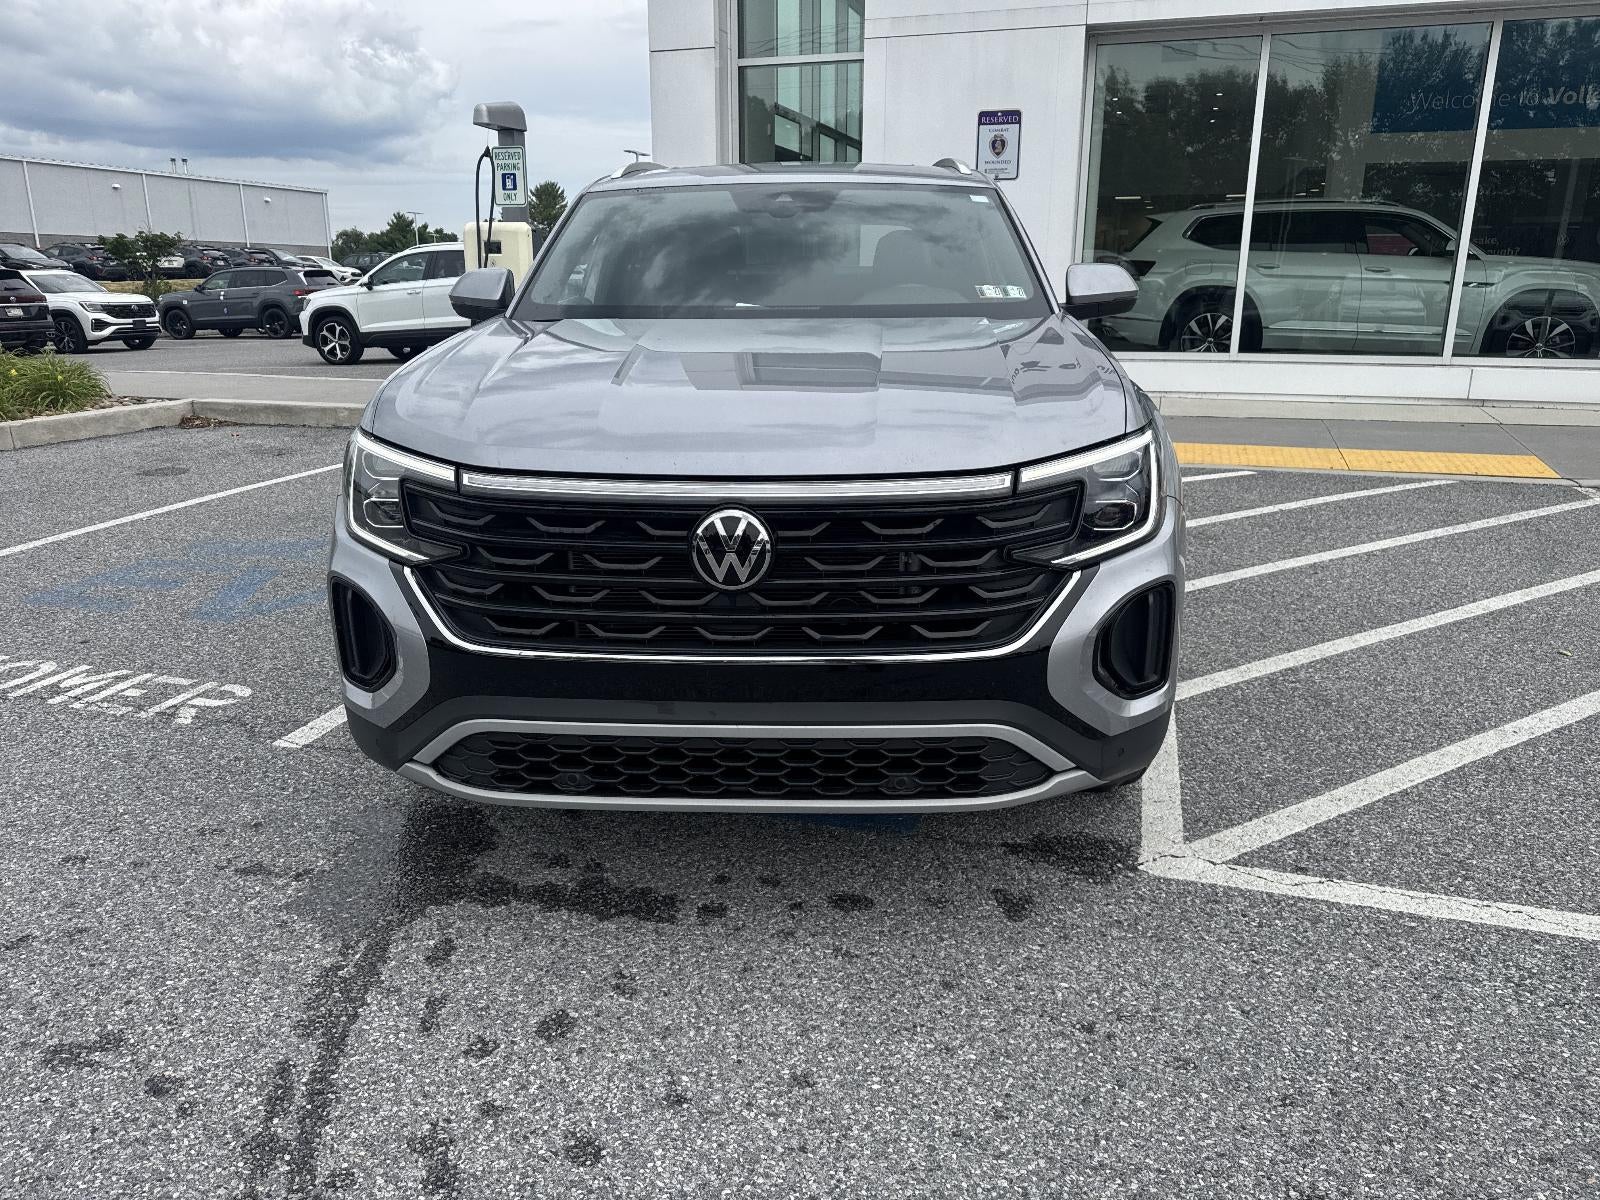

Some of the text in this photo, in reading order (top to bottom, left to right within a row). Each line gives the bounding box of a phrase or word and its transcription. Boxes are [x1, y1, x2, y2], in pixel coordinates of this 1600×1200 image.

[1410, 88, 1512, 110] Welcoe
[981, 115, 1019, 124] RESERVED
[494, 152, 521, 160] RESERVED
[496, 163, 520, 171] PARKING
[503, 193, 517, 201] ONLY
[693, 511, 769, 588] VW
